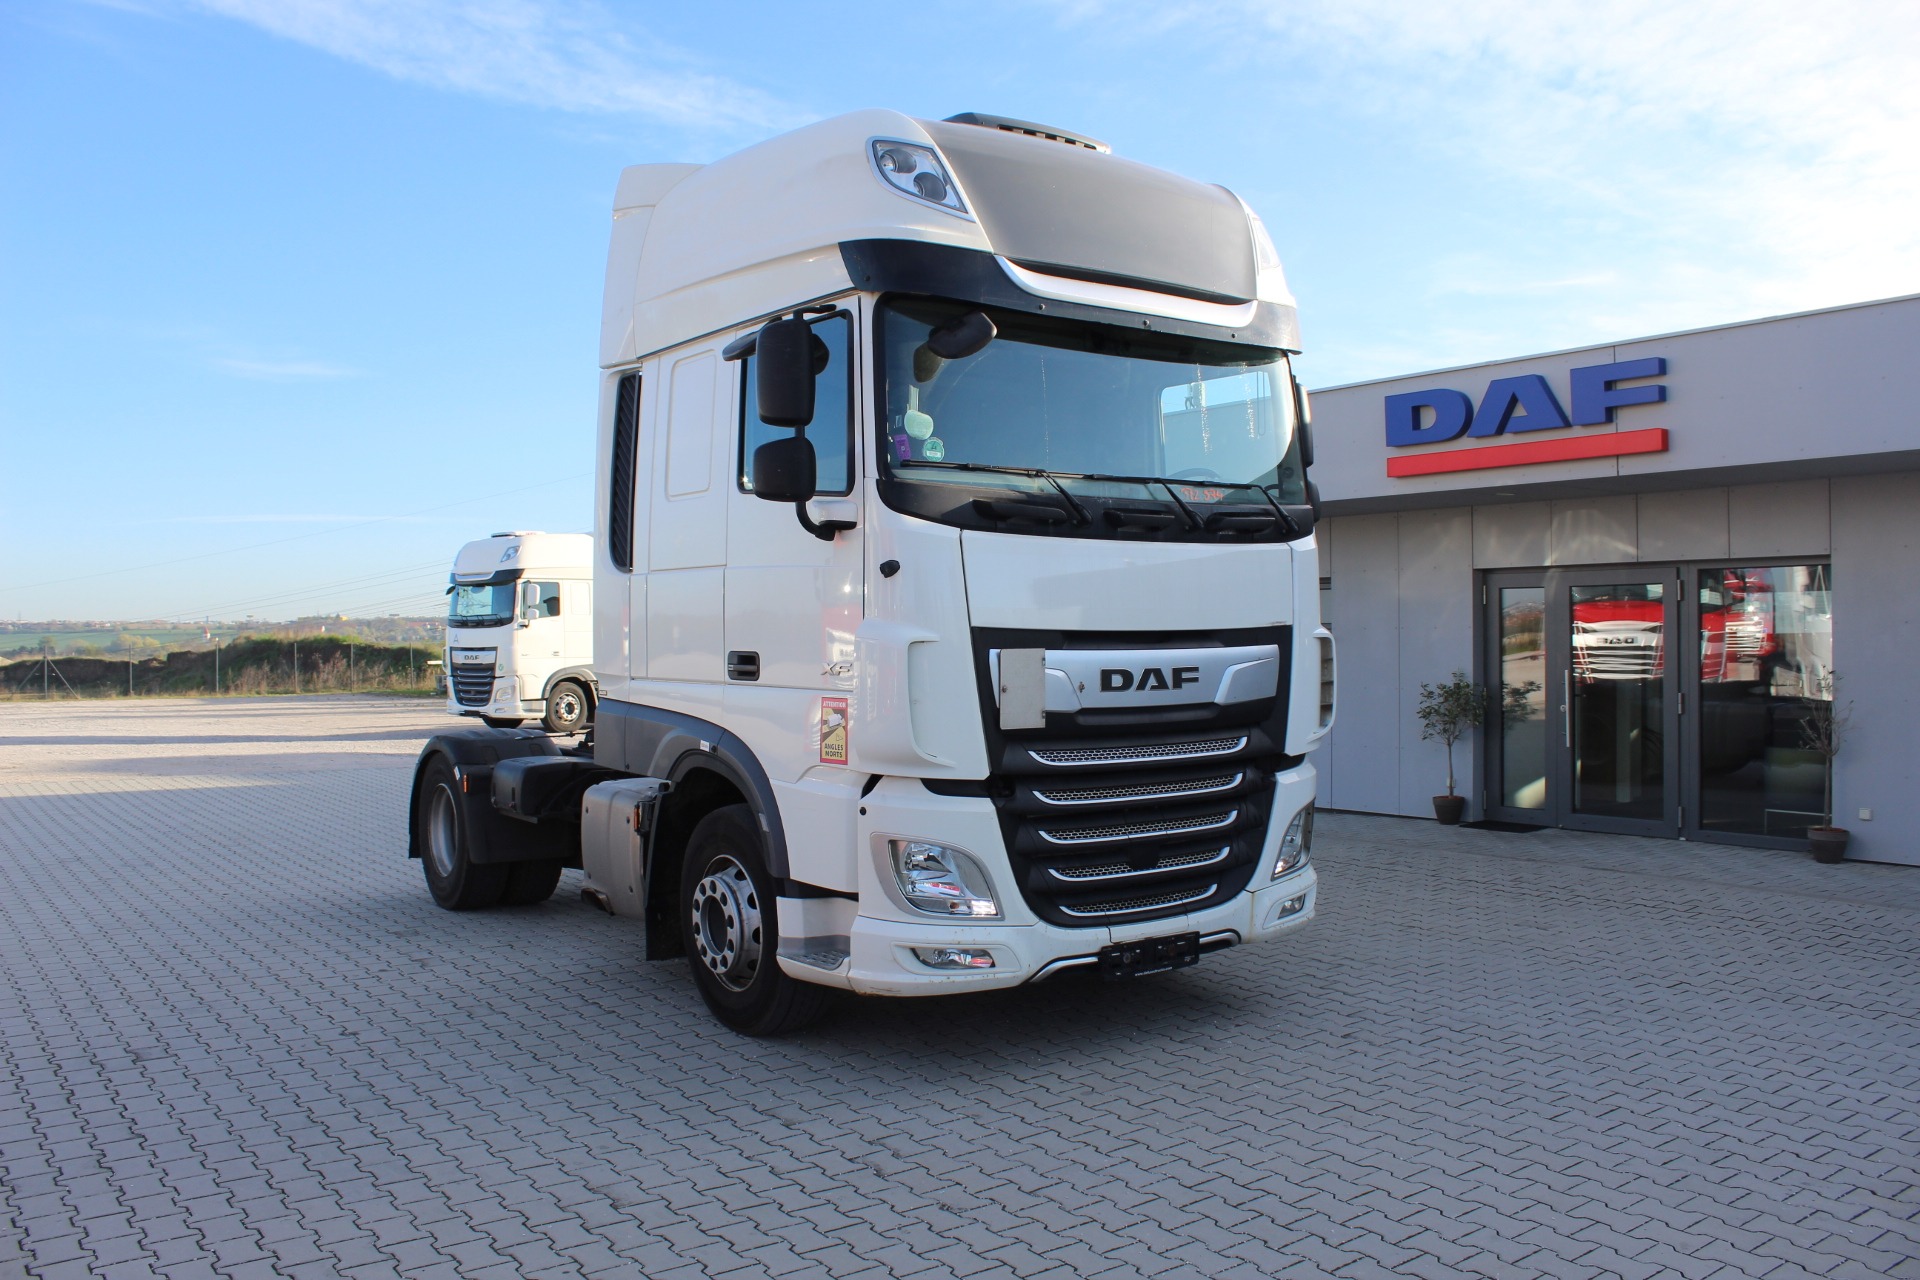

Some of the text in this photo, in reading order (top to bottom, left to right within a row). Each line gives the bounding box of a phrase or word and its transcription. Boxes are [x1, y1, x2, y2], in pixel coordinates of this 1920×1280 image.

[1384, 356, 1667, 448] DAF
[820, 662, 853, 676] XF
[1100, 666, 1199, 692] DAF
[824, 743, 844, 751] ANGLES
[825, 750, 843, 758] MORTS
